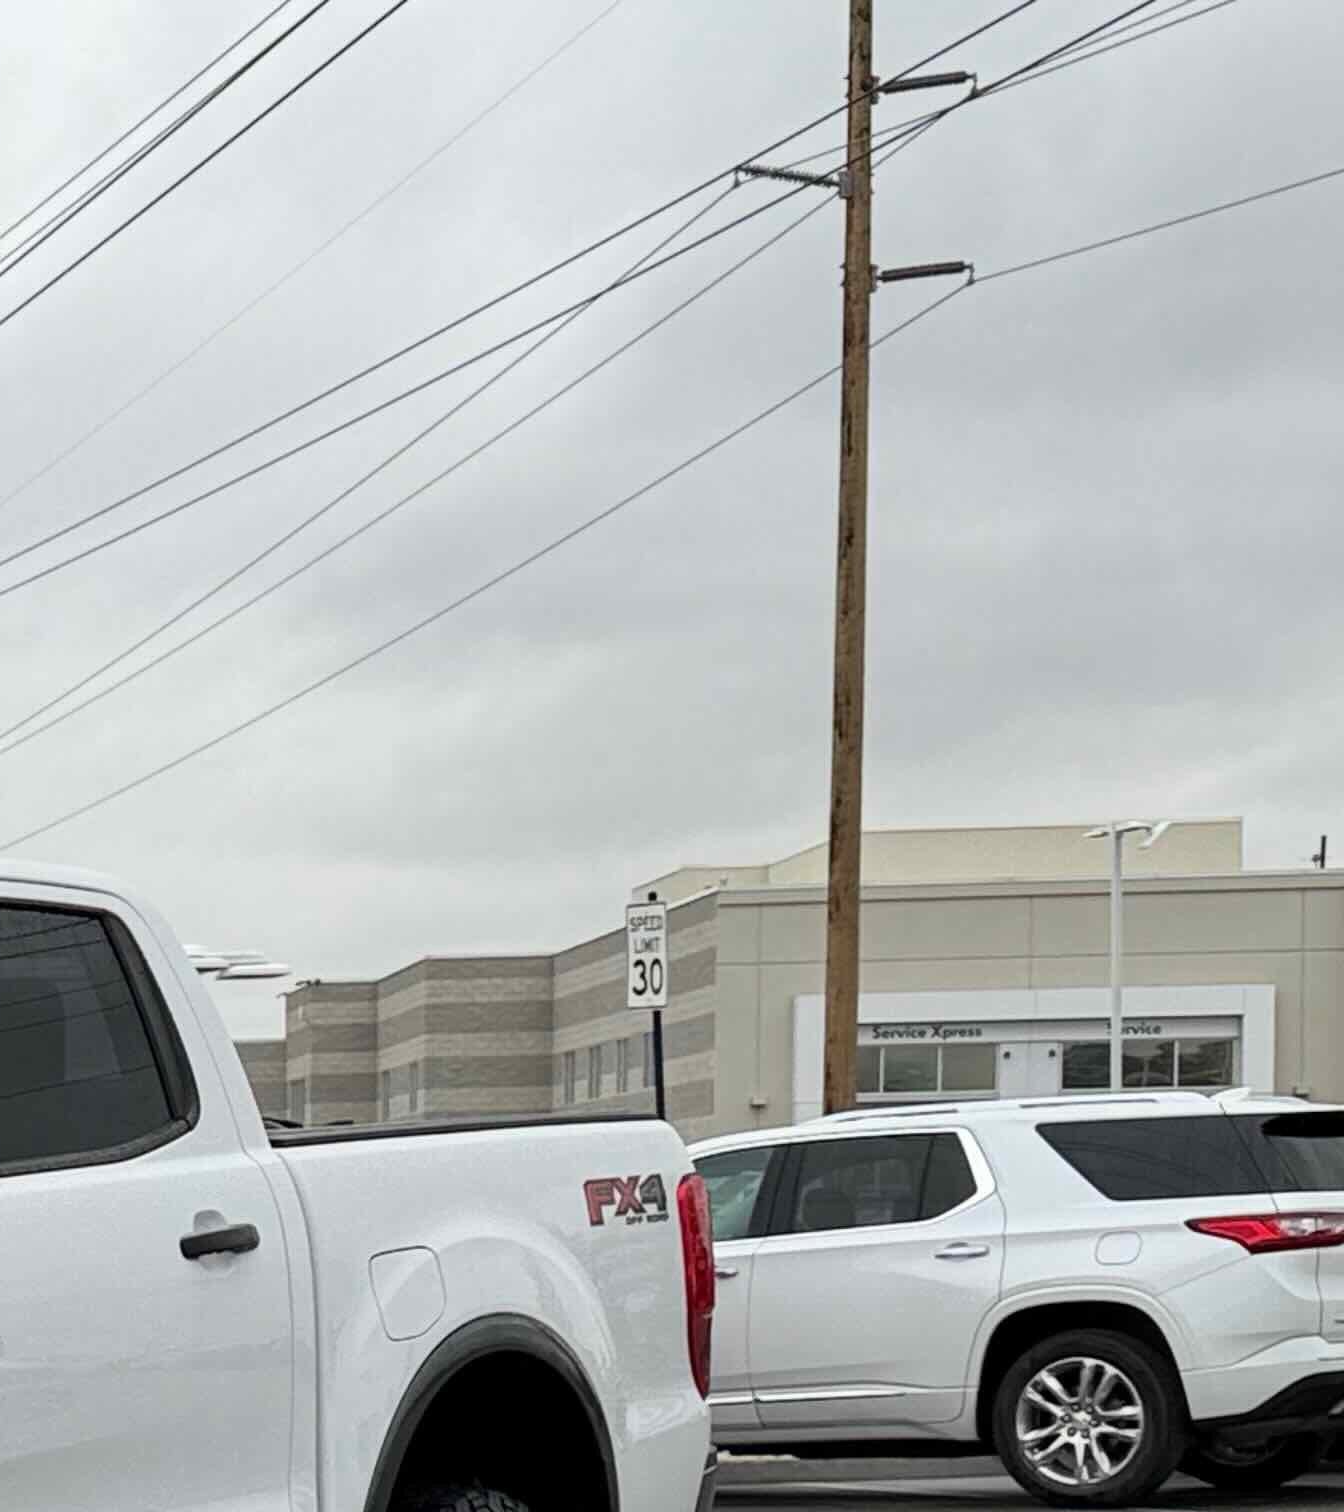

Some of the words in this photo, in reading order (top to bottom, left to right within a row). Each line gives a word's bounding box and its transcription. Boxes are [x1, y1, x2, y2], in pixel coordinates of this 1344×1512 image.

[632, 958, 663, 996] 30
[872, 1023, 927, 1039] Service
[930, 1022, 983, 1040] Xpress
[583, 1173, 668, 1227] FX4
